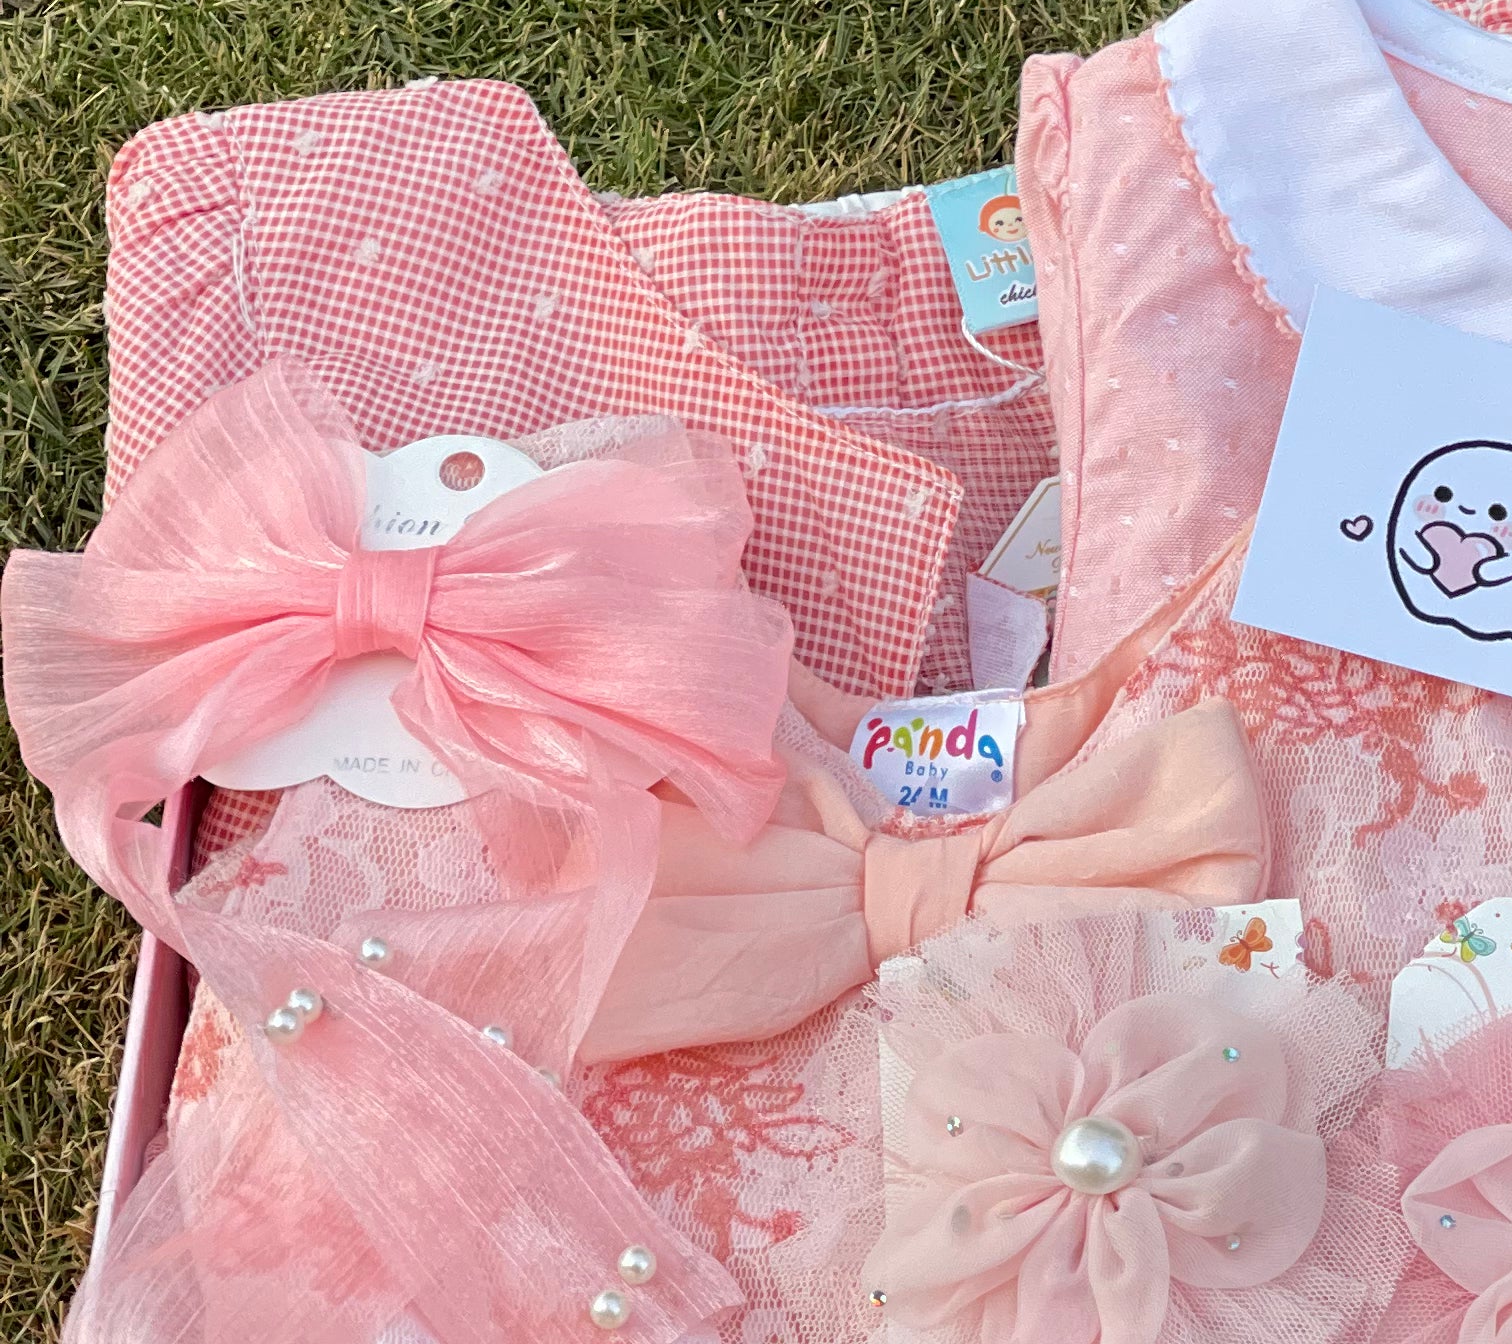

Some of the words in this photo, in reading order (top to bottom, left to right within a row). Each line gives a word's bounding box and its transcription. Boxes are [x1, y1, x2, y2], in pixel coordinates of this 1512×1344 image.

[965, 246, 1030, 281] Littl
[863, 709, 1005, 770] panda
[333, 757, 390, 774] MADE
[400, 758, 420, 774] IN
[905, 760, 949, 781] Baby
